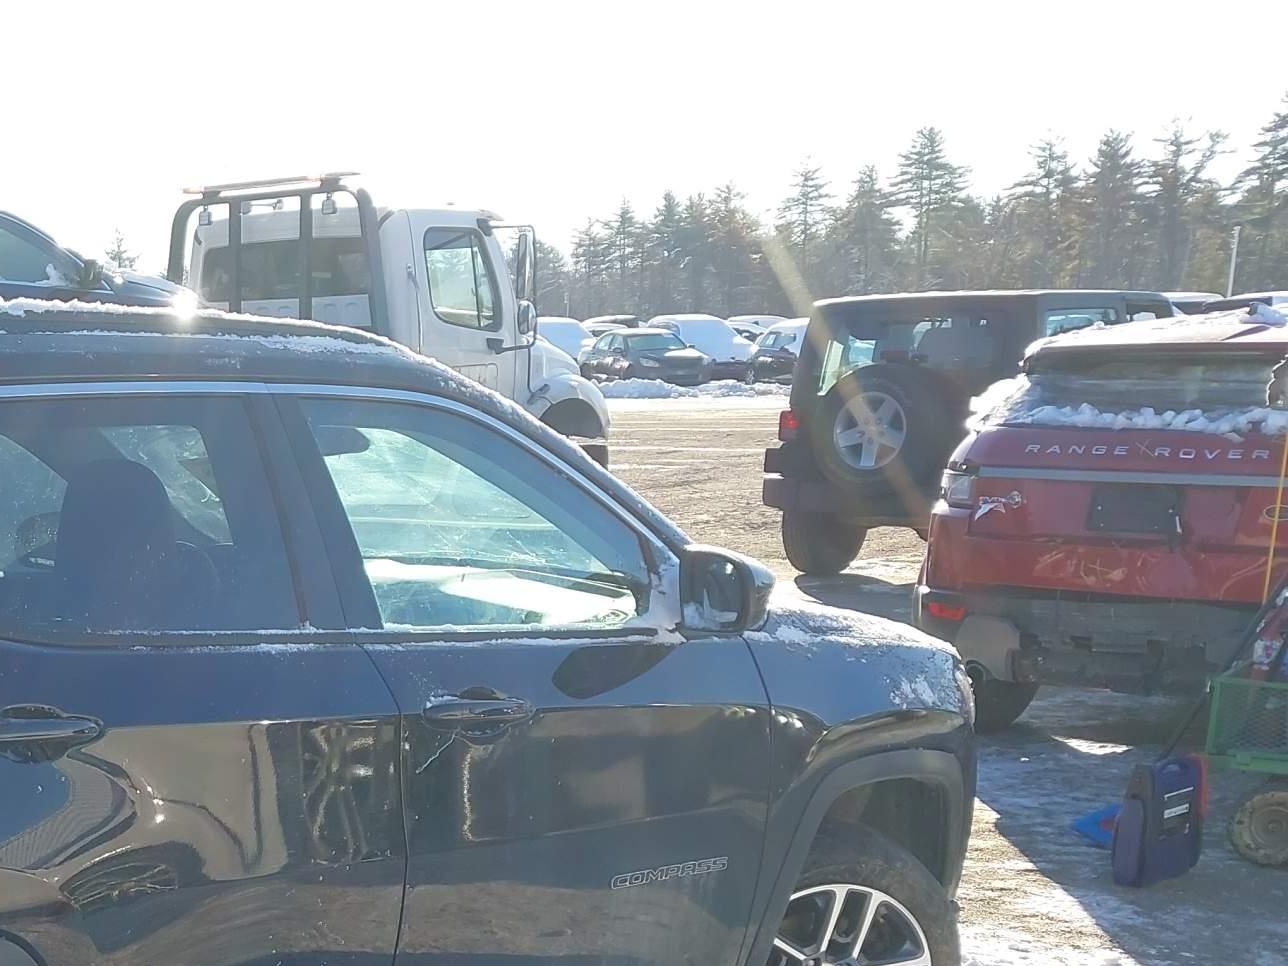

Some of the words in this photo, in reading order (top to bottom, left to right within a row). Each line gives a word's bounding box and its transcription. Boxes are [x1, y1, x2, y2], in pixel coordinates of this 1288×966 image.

[1024, 443, 1130, 456] RANGE
[1153, 445, 1272, 460] ROVER
[611, 856, 729, 890] COMPASS
